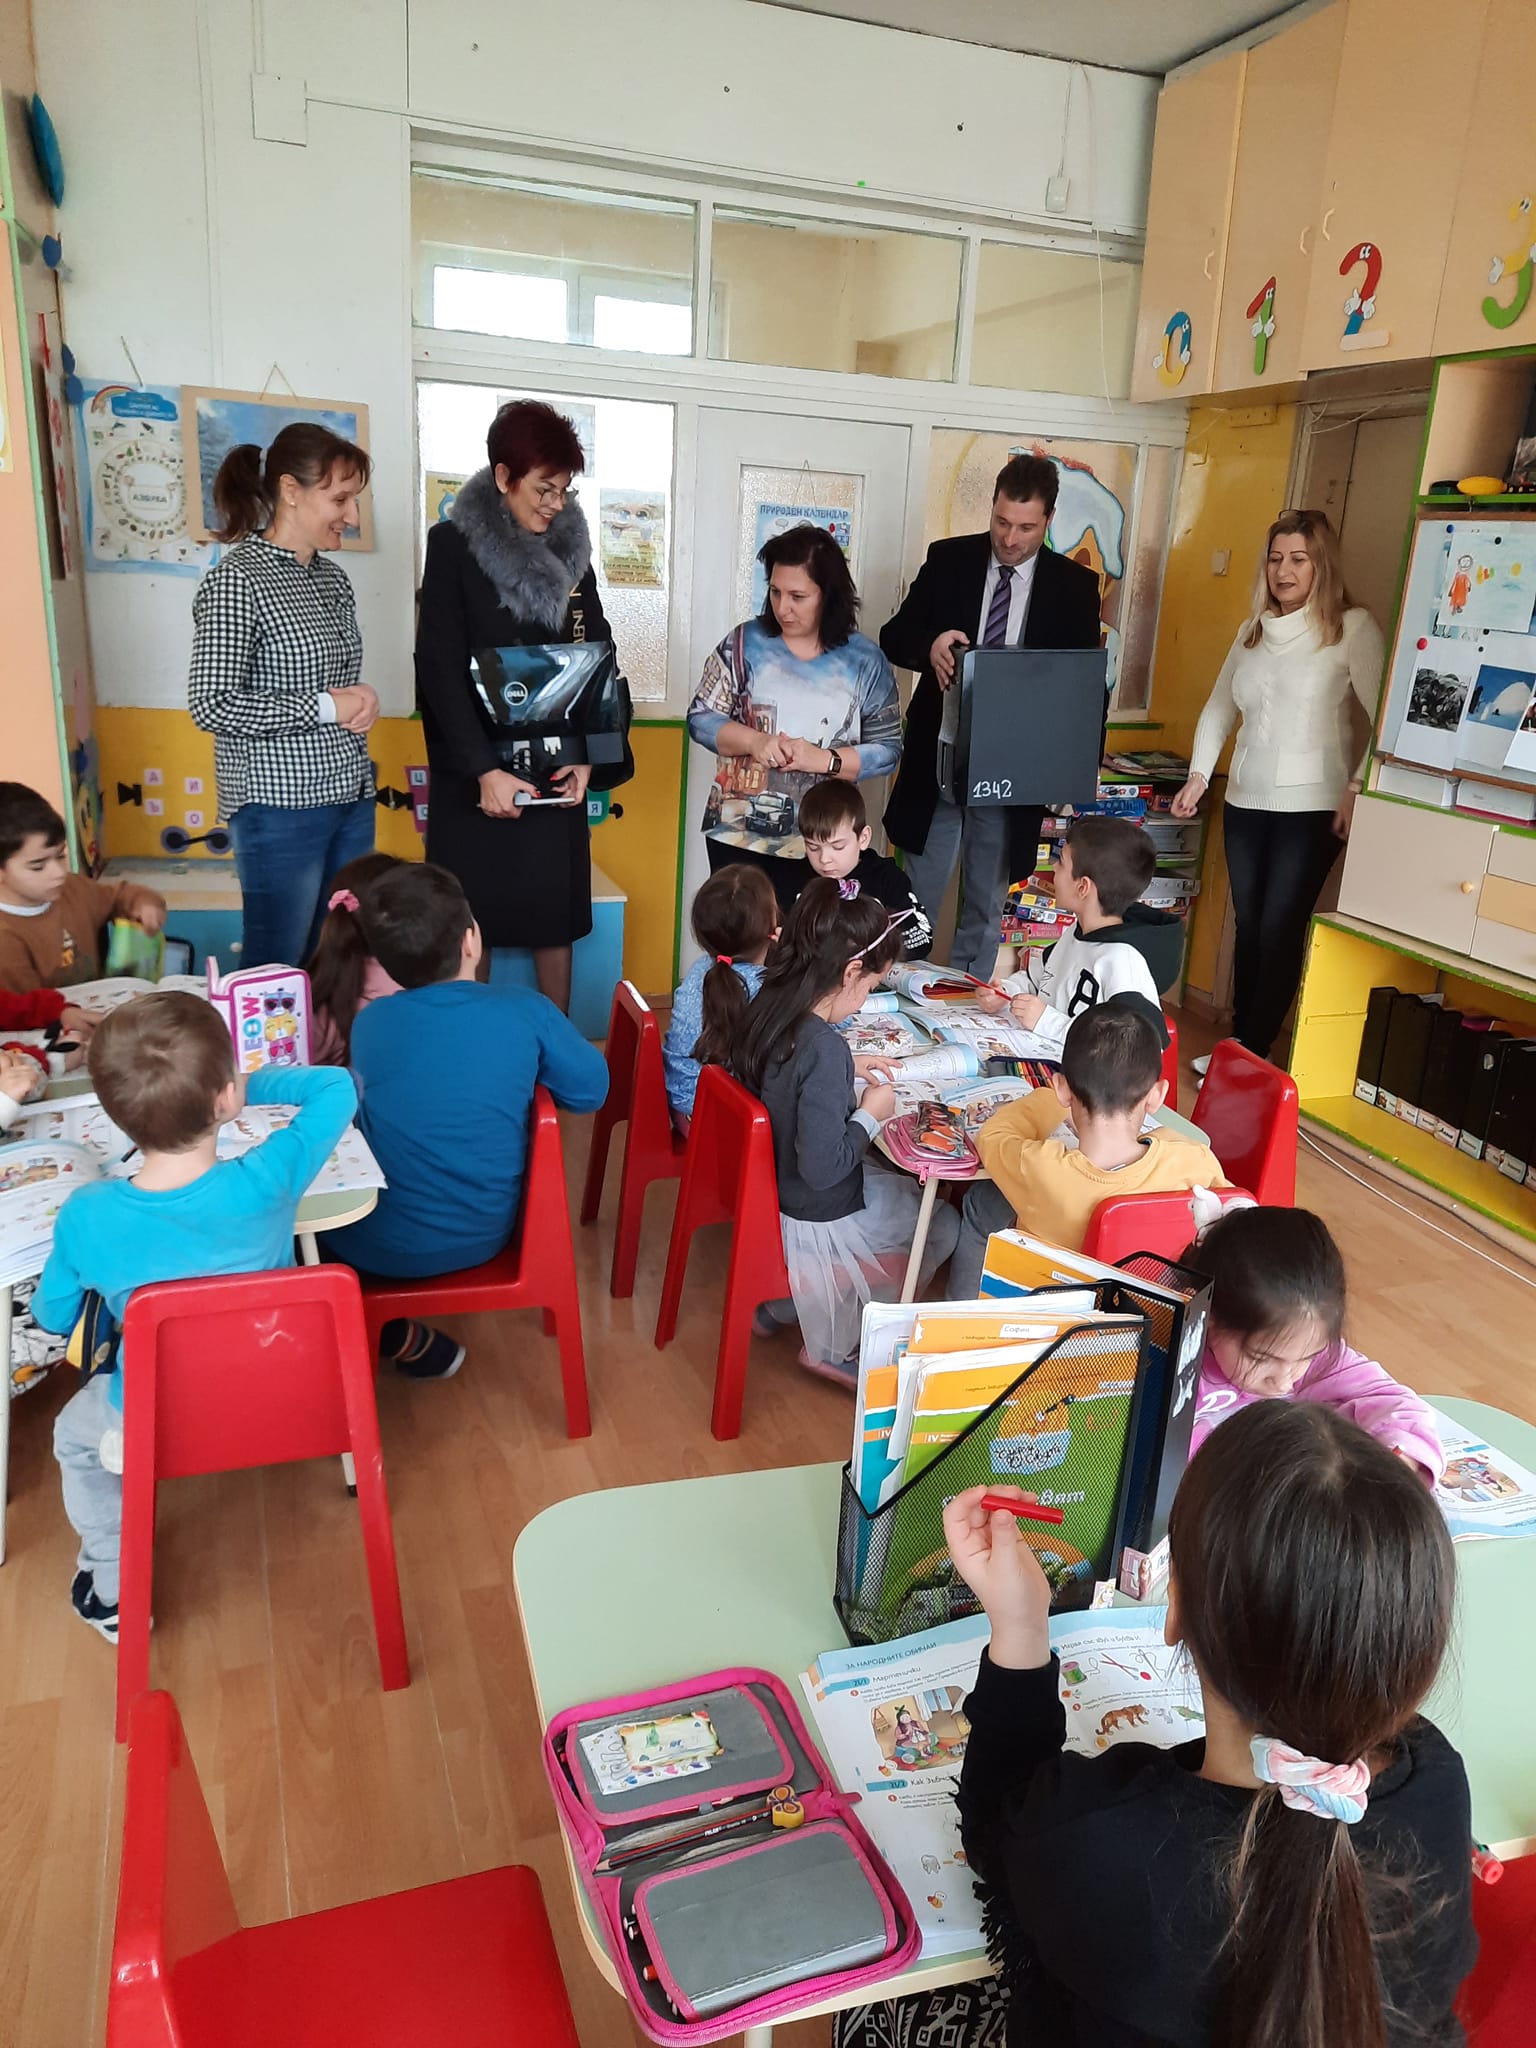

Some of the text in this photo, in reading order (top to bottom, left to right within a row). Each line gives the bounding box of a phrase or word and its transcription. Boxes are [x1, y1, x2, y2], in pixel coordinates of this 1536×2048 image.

[1339, 242, 1390, 351] 2
[1246, 276, 1277, 375] 1
[760, 504, 849, 520] ПРИРОДЕН КАЛЕНДАР
[973, 779, 1012, 800] 1342
[241, 996, 263, 1073] MEOW
[927, 1434, 939, 1443] IV
[855, 1653, 903, 1669] НАРОДНИТЕ
